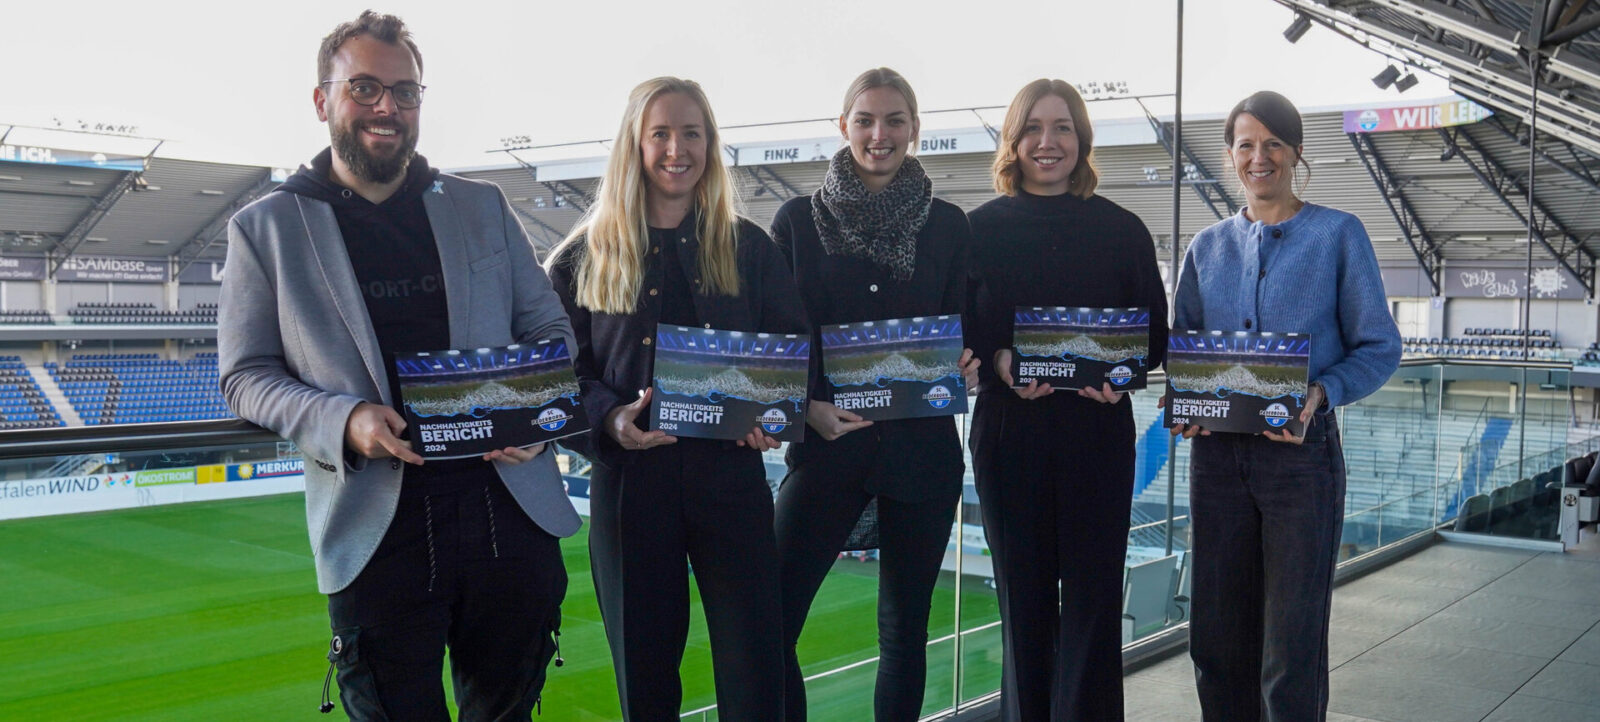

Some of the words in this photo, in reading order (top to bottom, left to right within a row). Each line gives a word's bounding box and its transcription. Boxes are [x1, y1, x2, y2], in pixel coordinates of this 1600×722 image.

[1393, 106, 1443, 128] WIR
[764, 147, 800, 161] FINKE
[1019, 366, 1077, 378] BERICHT
[834, 389, 892, 400] NACHHALTIGKEITS
[660, 401, 724, 413] NACHHALTIGKEITS
[834, 395, 893, 410] BERICHT
[1173, 398, 1230, 407] NACHHALTIGKEITS
[659, 408, 724, 425] BERICHT
[1172, 405, 1230, 418] BERICHT
[419, 419, 493, 431] NACHHALTIGKEITS
[658, 422, 678, 431] 2024
[420, 426, 494, 443] BERICHT
[424, 444, 447, 452] 2024
